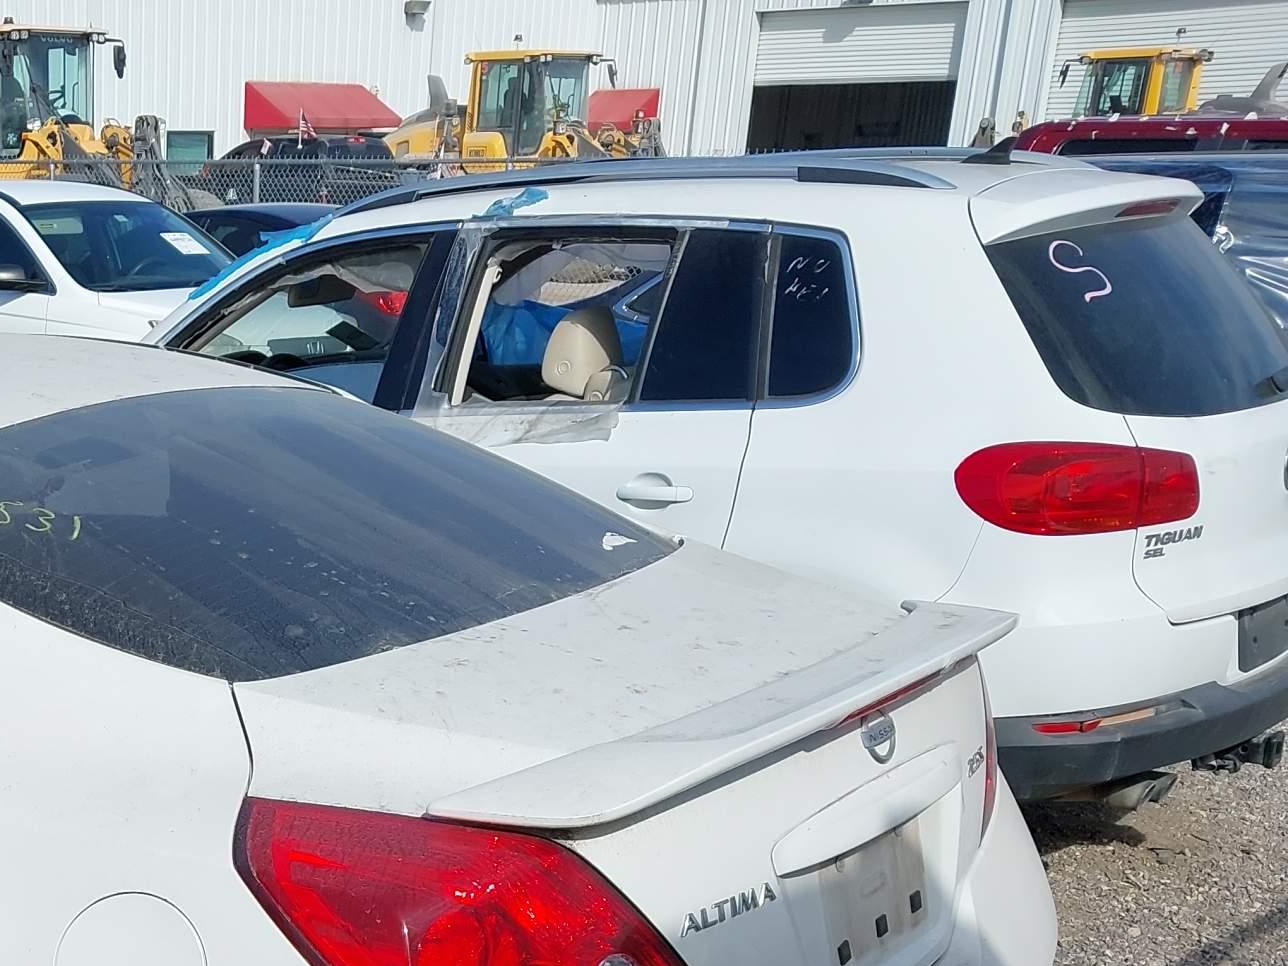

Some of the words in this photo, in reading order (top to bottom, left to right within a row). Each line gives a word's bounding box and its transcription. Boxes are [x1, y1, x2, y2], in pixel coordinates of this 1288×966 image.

[1144, 525, 1204, 548] TIGUAN
[1143, 547, 1166, 560] SEL
[680, 882, 777, 938] ALTIMA
